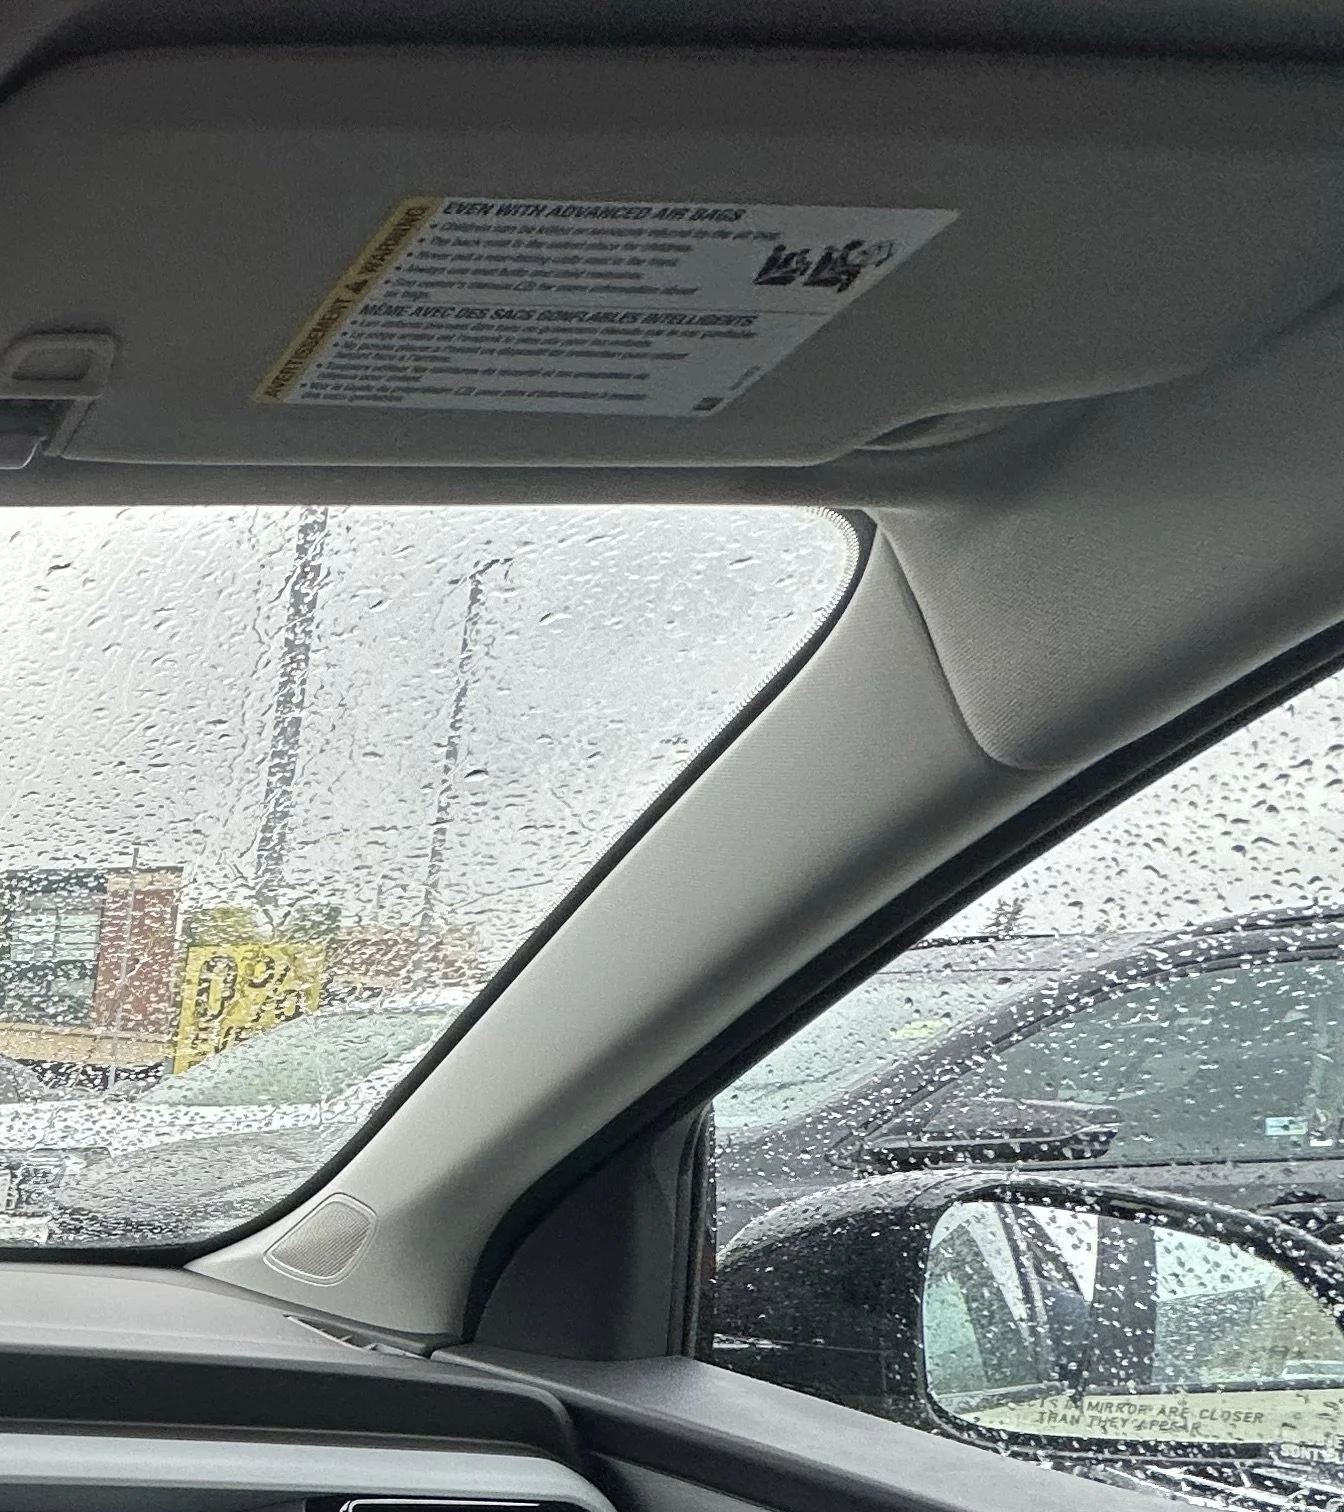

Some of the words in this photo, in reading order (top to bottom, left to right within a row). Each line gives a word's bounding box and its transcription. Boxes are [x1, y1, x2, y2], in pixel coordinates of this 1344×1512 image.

[440, 201, 496, 215] EVEN
[492, 203, 550, 217] WITH
[544, 204, 654, 219] ADVANCED
[648, 207, 692, 220] AIR
[685, 208, 749, 222] BAGS
[1036, 1411, 1081, 1426] THAN
[1087, 1414, 1129, 1430] THEY
[1086, 1401, 1152, 1416] MIRROR
[1156, 1404, 1191, 1419] ARE
[1199, 1407, 1265, 1424] CLOSER
